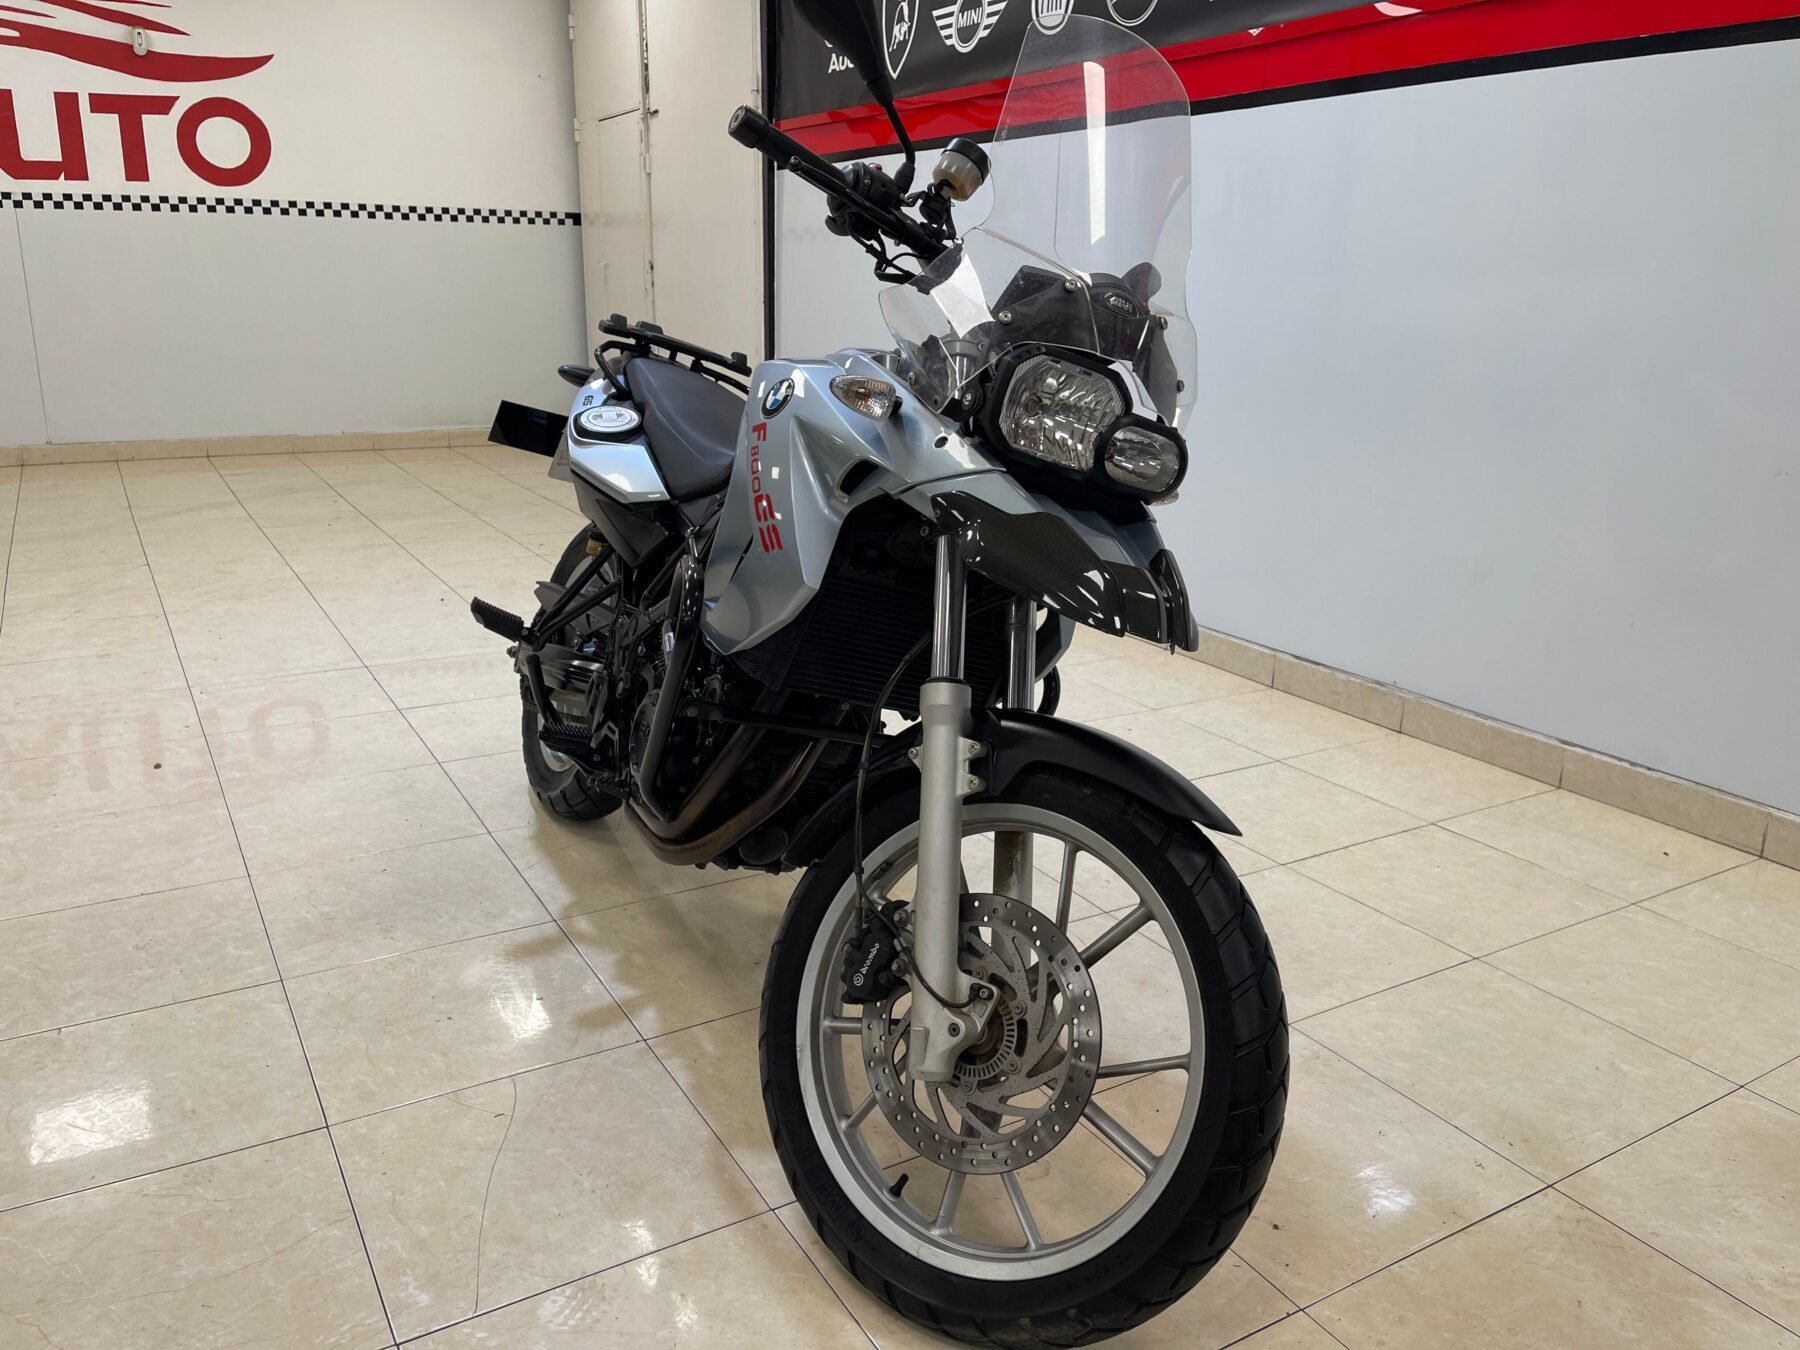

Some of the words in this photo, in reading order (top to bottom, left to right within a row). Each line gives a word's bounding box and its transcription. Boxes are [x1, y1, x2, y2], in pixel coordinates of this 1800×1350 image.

[957, 6, 982, 29] MINI
[582, 394, 594, 406] GS
[860, 943, 880, 974] brembo
